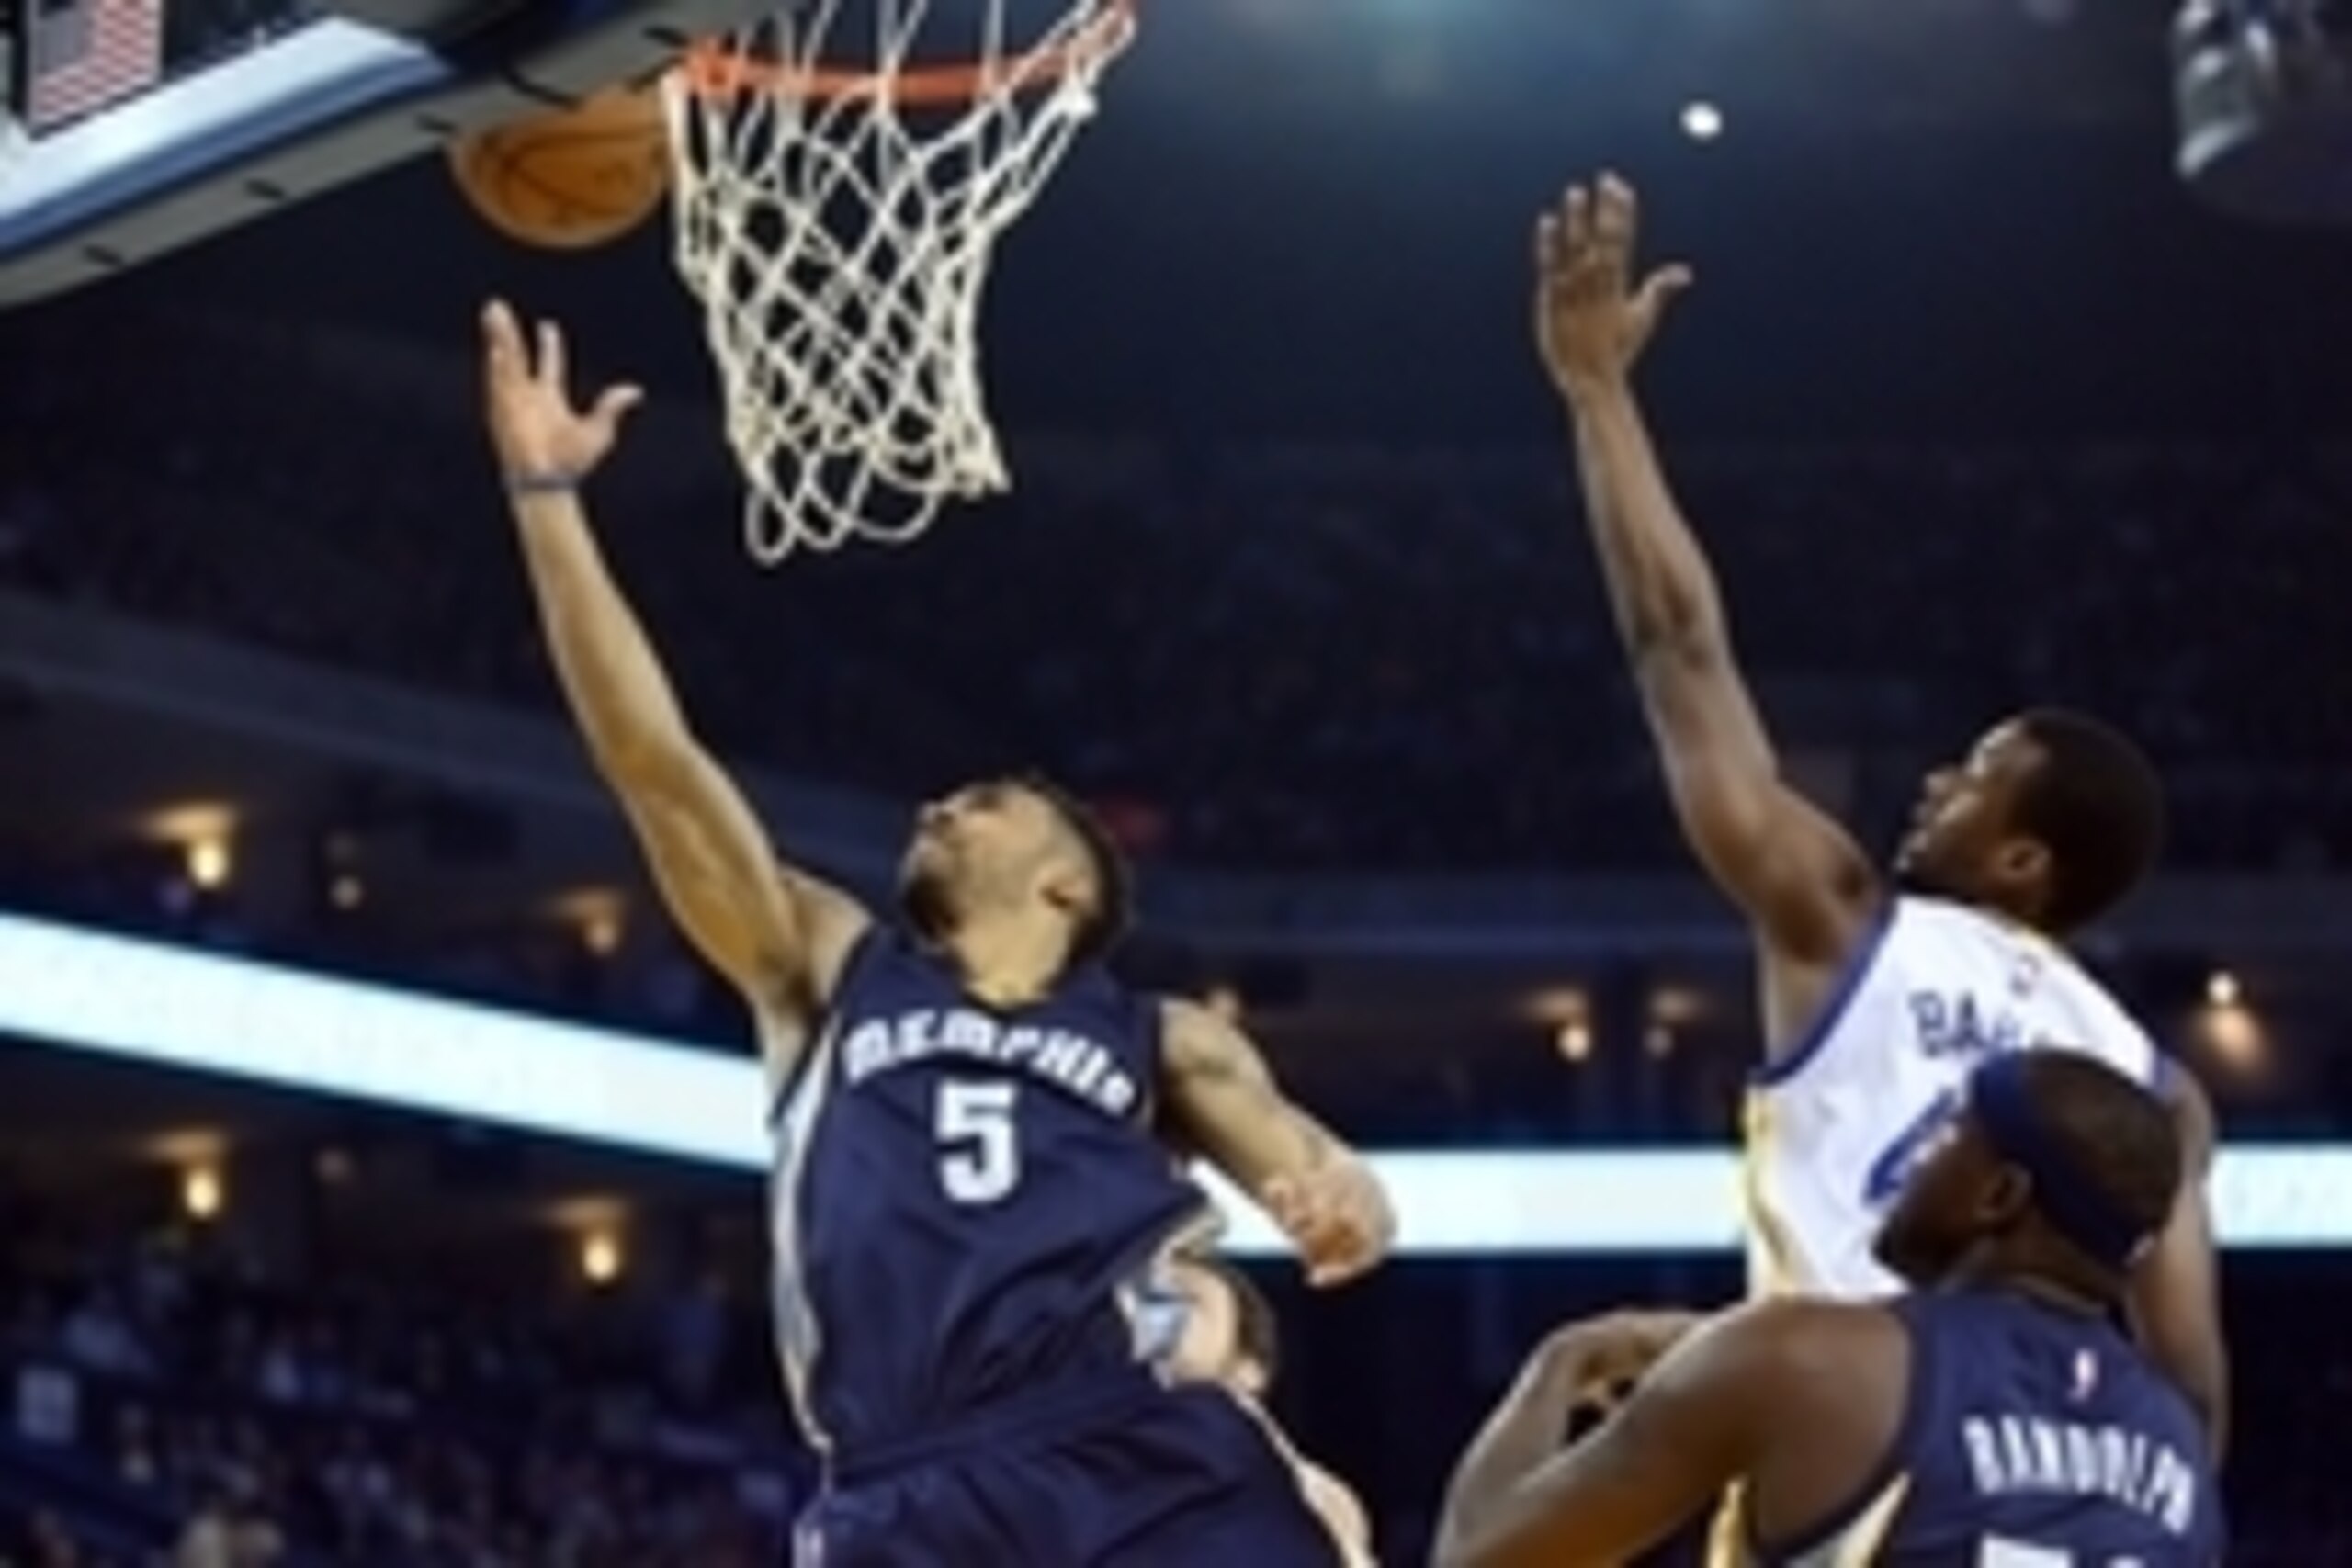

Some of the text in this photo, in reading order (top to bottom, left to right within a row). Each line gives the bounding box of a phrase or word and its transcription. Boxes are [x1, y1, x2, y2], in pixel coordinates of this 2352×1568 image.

[843, 1009, 1136, 1114] MEMPHIS
[937, 1079, 1018, 1201] 5
[1963, 1416, 2194, 1533] RANDOLPH
